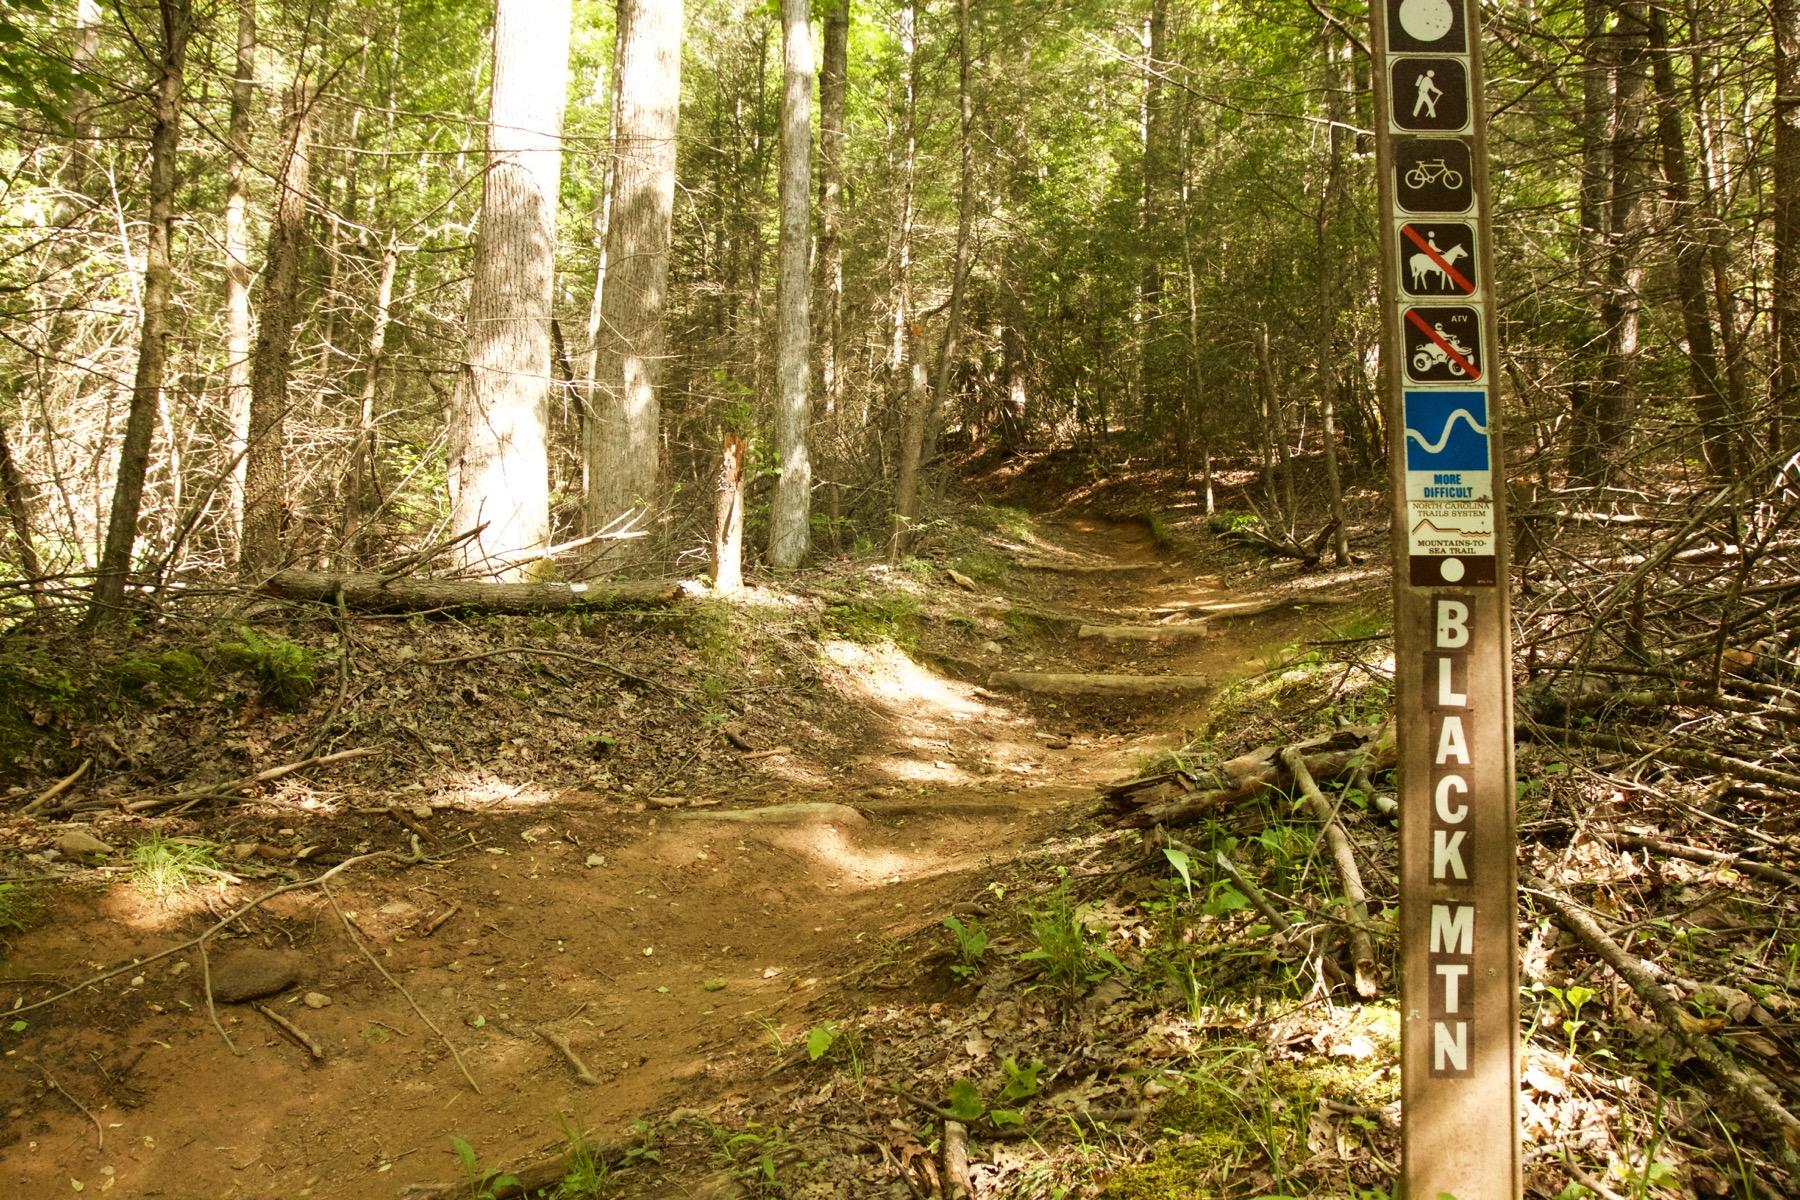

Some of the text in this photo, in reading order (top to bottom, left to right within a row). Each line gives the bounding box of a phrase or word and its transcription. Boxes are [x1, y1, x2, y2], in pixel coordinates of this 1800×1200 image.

[1434, 474, 1462, 485] MORE
[1424, 487, 1473, 498] DIFFICULT
[1430, 600, 1474, 1070] BLACK MTN
